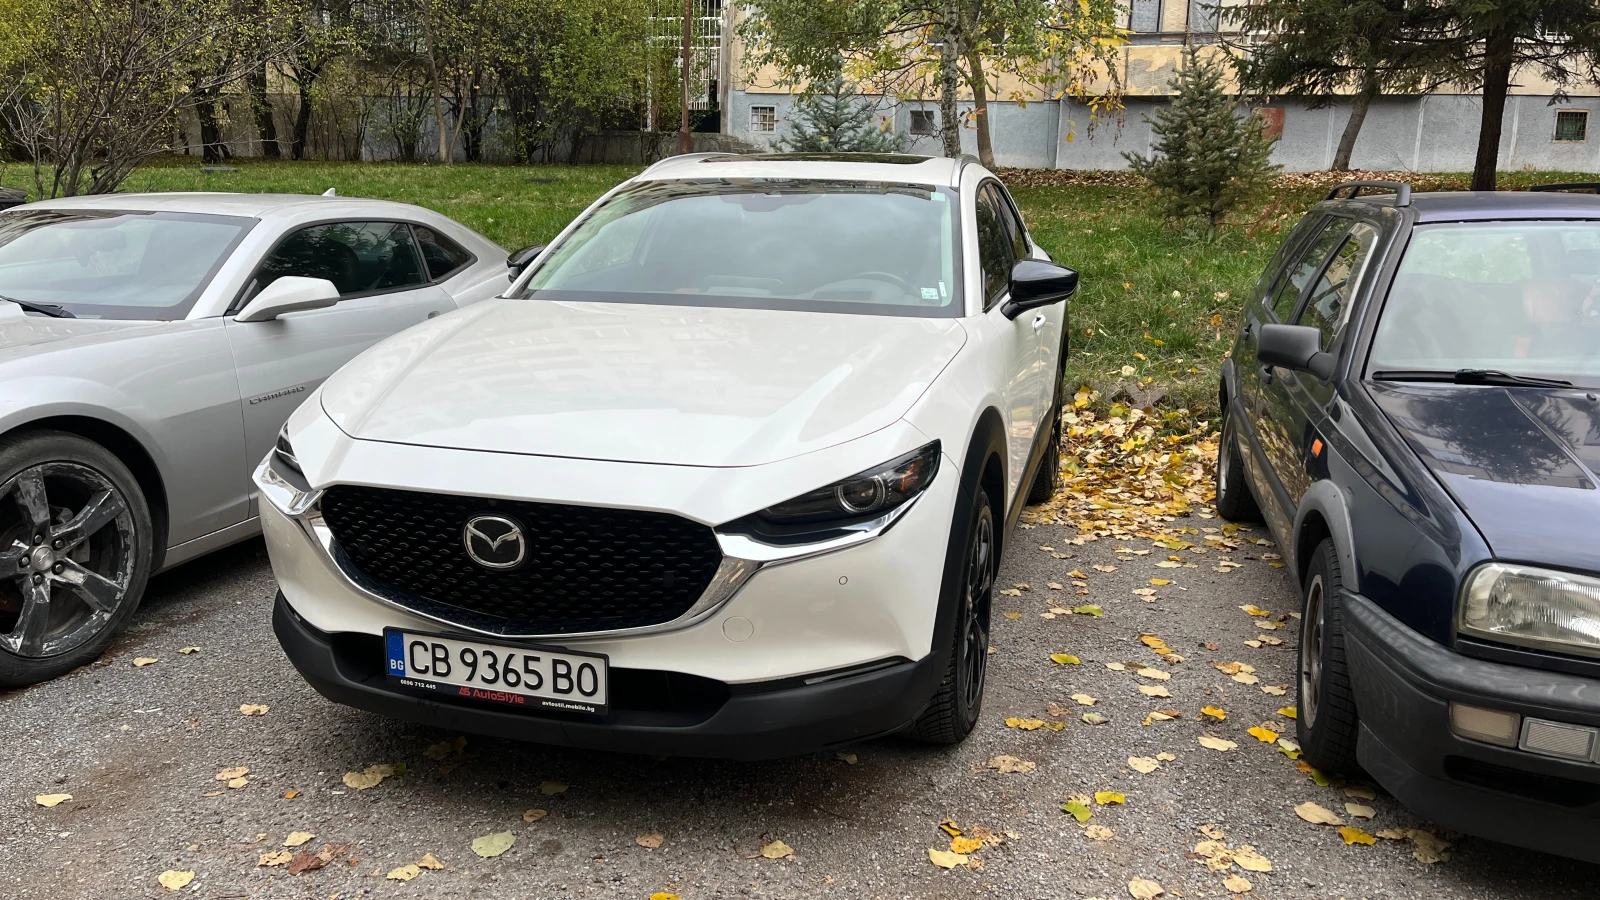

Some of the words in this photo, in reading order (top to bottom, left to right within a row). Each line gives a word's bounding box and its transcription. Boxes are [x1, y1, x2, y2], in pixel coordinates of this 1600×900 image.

[390, 659, 404, 670] BG
[409, 640, 451, 677] CB
[459, 647, 544, 690] 9365
[472, 688, 525, 704] AutoStyle
